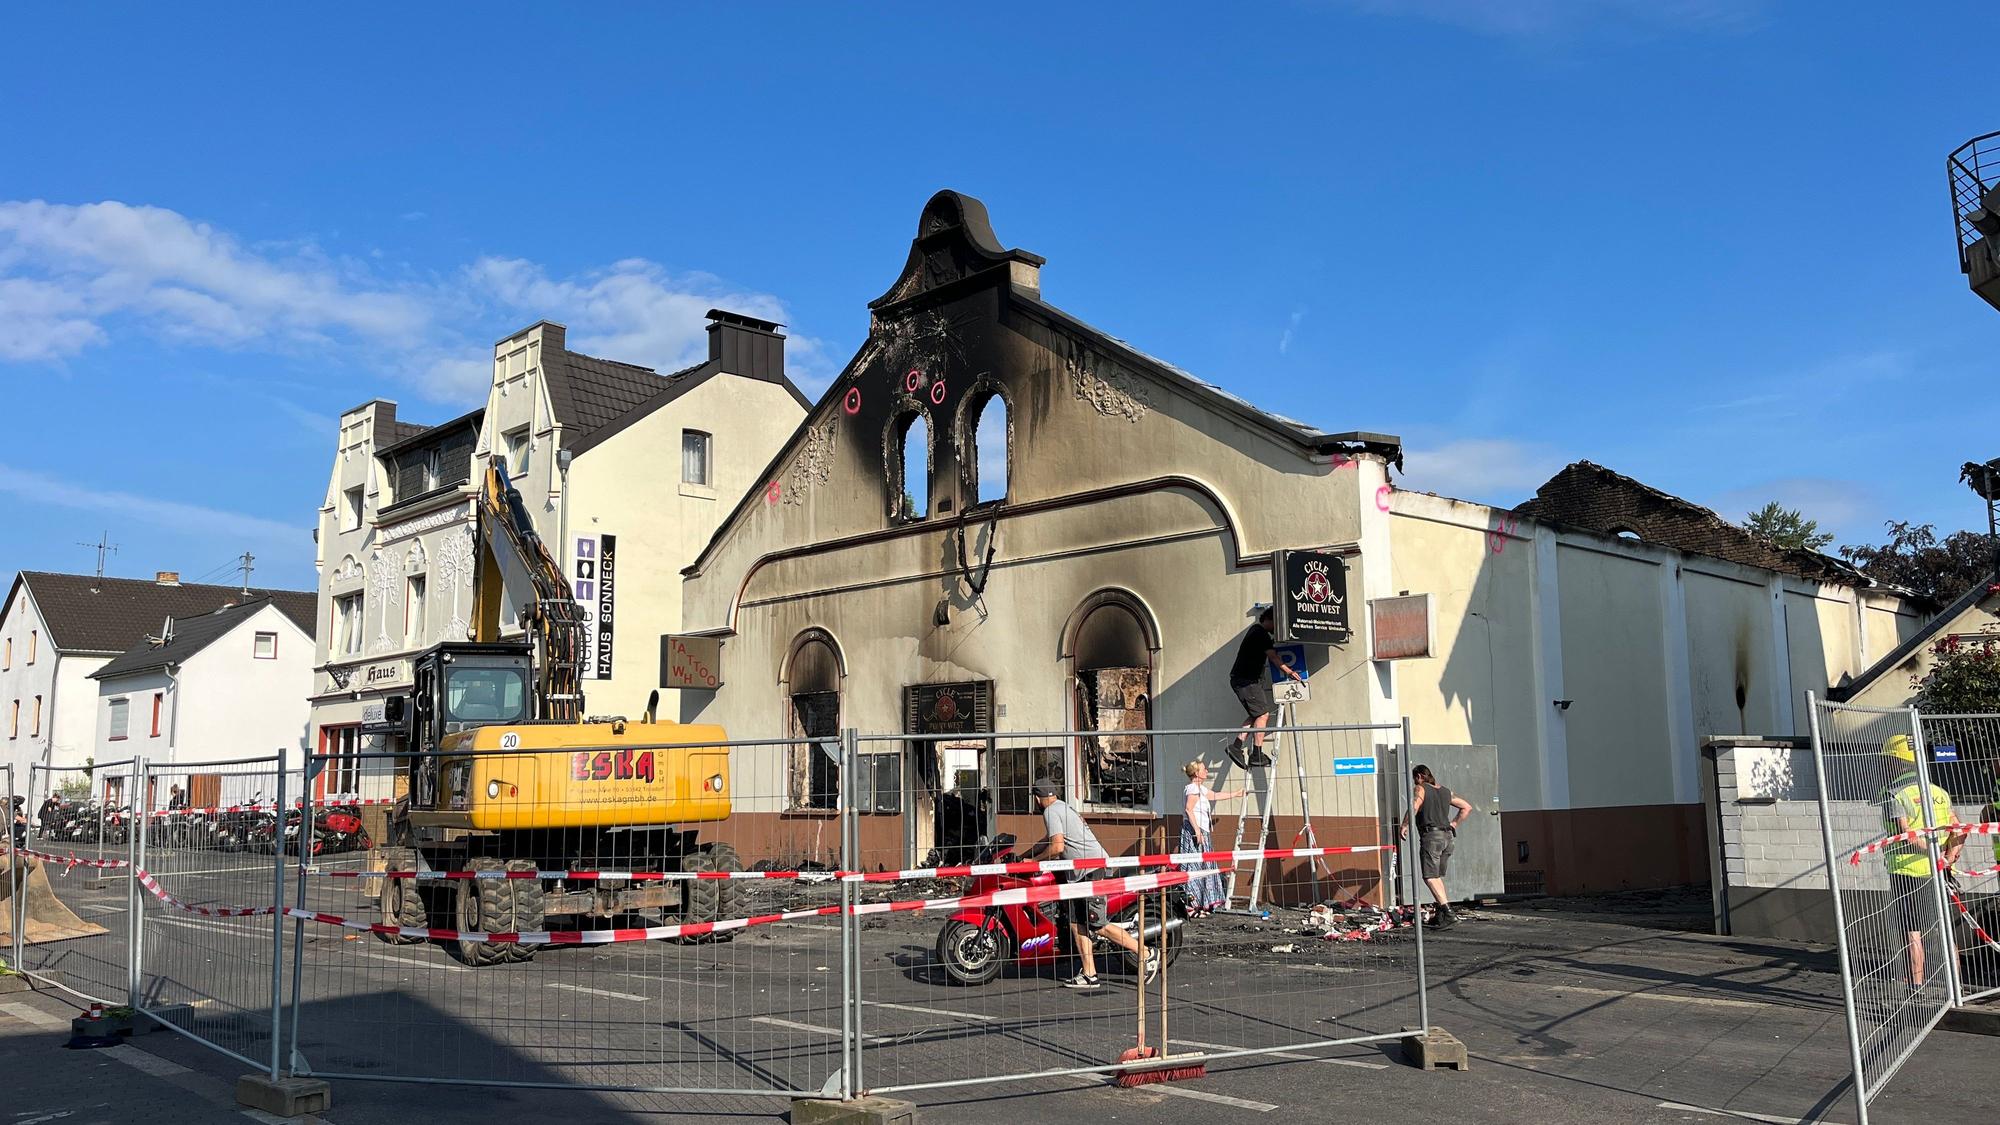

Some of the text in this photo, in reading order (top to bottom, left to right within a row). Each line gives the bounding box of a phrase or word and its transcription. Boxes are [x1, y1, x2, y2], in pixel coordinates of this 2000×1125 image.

[1304, 561, 1329, 576] CYCLE
[600, 551, 613, 674] HAUS SONNECK
[1297, 602, 1340, 615] POINT WEST
[670, 639, 716, 686] TATTOO
[368, 666, 396, 683] Haus
[672, 665, 692, 684] WH
[363, 702, 382, 721] deluxe
[503, 734, 517, 748] 20
[571, 749, 654, 783] ESKA
[580, 795, 657, 804] www.eskagmbh.de
